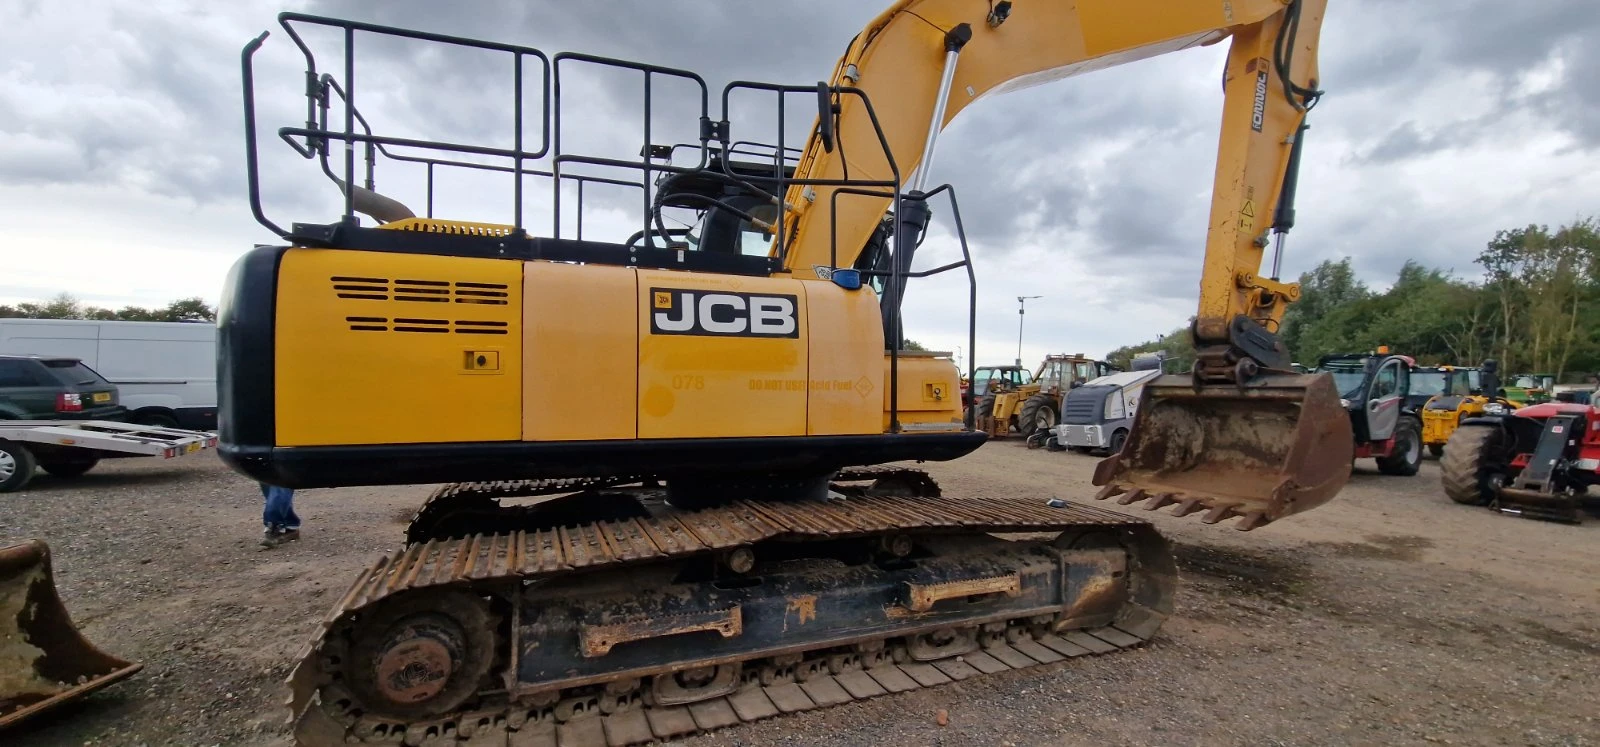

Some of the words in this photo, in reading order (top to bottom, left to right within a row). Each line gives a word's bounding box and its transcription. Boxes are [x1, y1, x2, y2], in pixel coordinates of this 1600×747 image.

[655, 292, 796, 334] JCB
[672, 374, 705, 390] 078
[749, 379, 763, 391] DO
[764, 379, 782, 391] NOT
